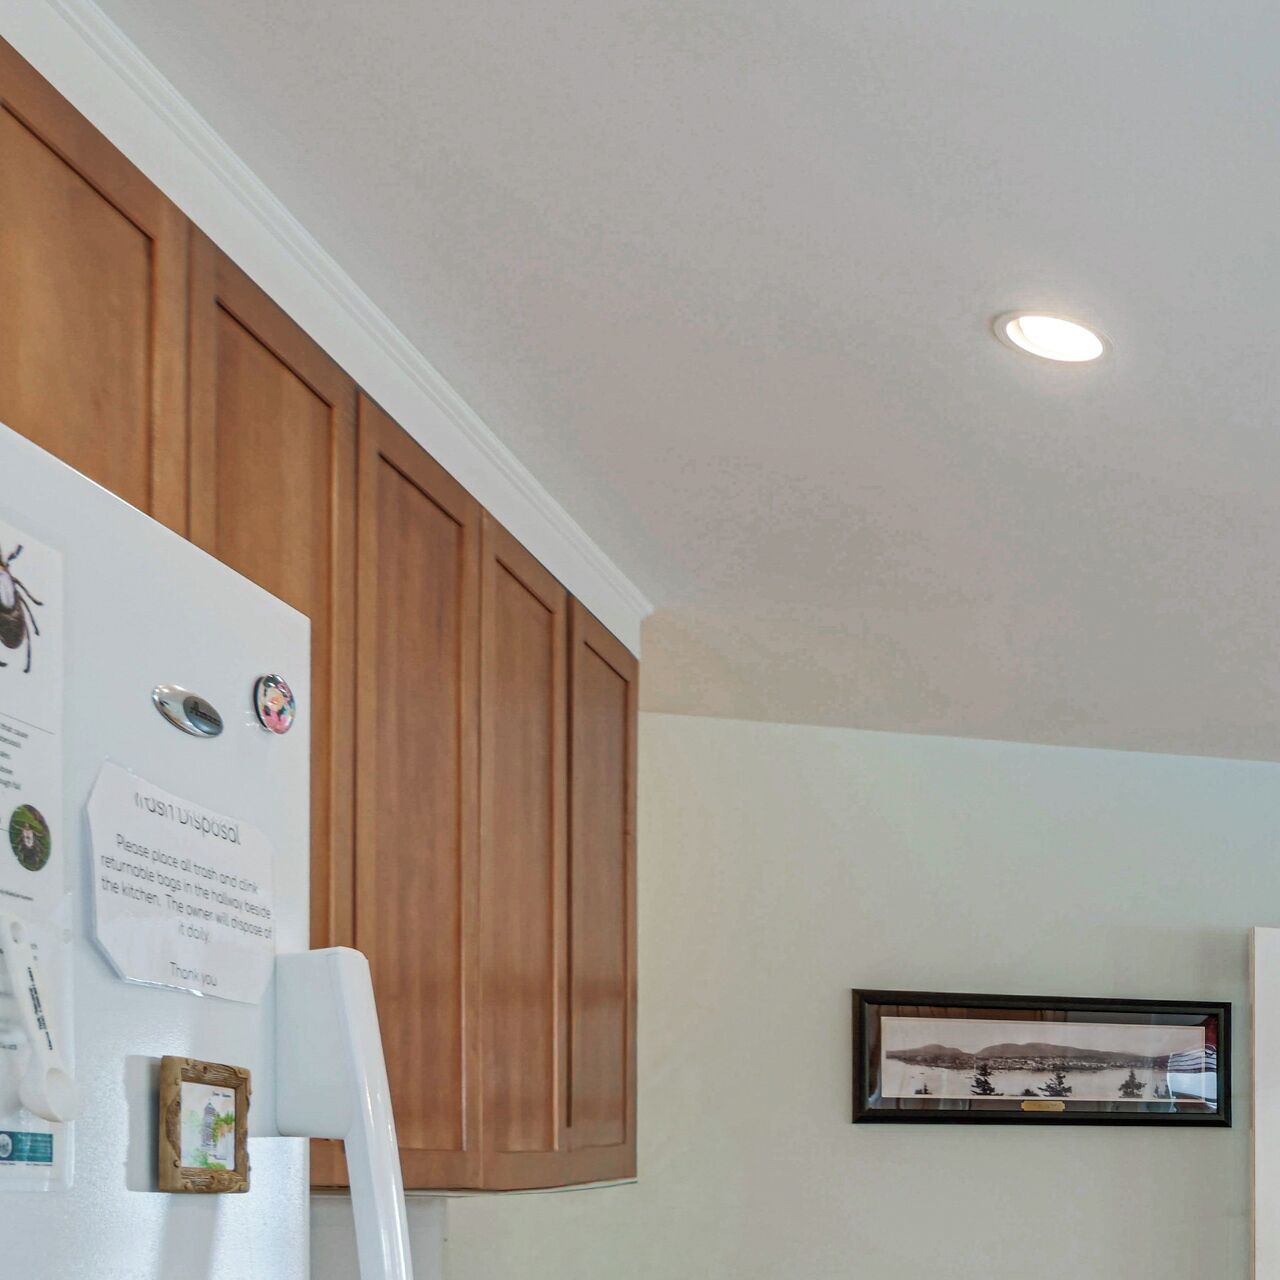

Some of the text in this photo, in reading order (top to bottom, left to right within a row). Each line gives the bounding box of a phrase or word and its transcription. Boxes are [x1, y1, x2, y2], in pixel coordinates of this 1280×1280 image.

[101, 855, 155, 883] returnable
[157, 870, 182, 892] bags
[195, 881, 210, 900] the
[116, 833, 150, 859] Please
[151, 848, 178, 868] place
[181, 857, 192, 873] all
[194, 861, 218, 881] trash
[220, 872, 238, 889] and
[101, 875, 119, 895] the
[165, 893, 184, 914] The
[169, 960, 218, 988] Thank you
